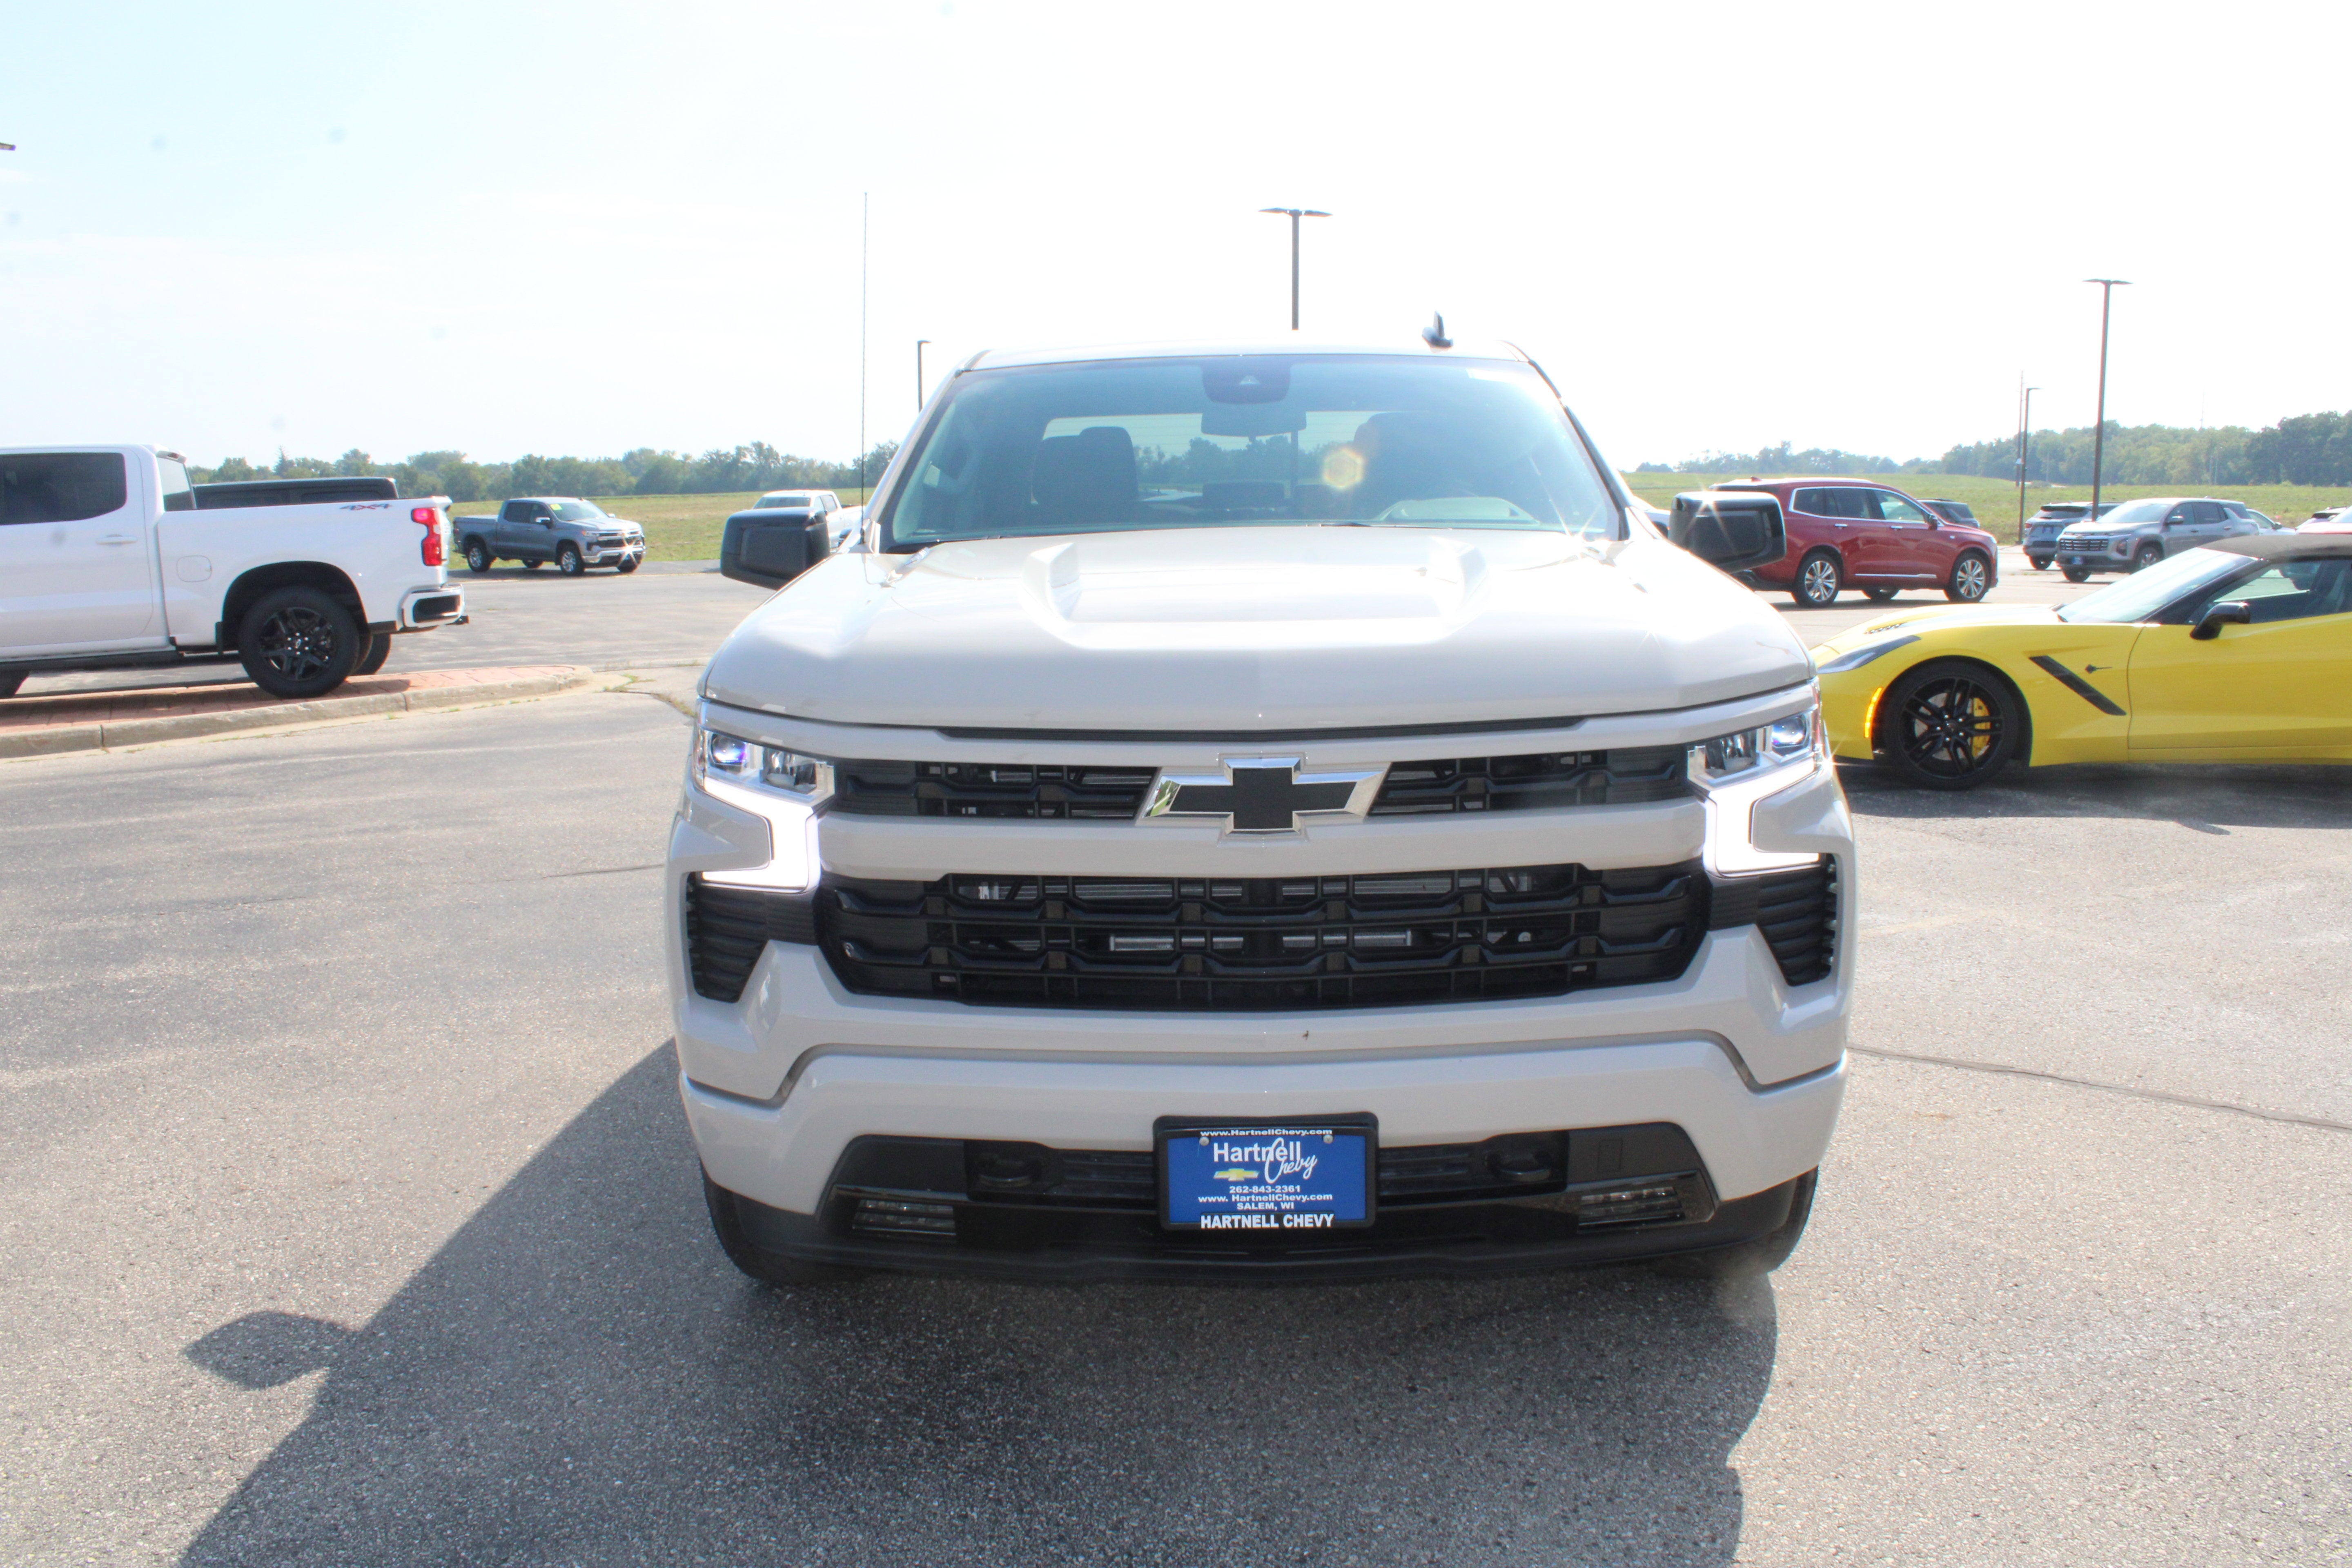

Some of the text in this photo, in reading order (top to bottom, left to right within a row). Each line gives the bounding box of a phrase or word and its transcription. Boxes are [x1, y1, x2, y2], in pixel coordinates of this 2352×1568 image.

[1213, 1140, 1301, 1162] Hartnell
[1264, 1137, 1318, 1184] Chevy
[1229, 1185, 1301, 1194] 262-843-2361
[1232, 1194, 1333, 1202] HartnellChevy.com
[1236, 1203, 1278, 1211] SALEM,
[1200, 1214, 1334, 1229] HARTNELL CHEVY
